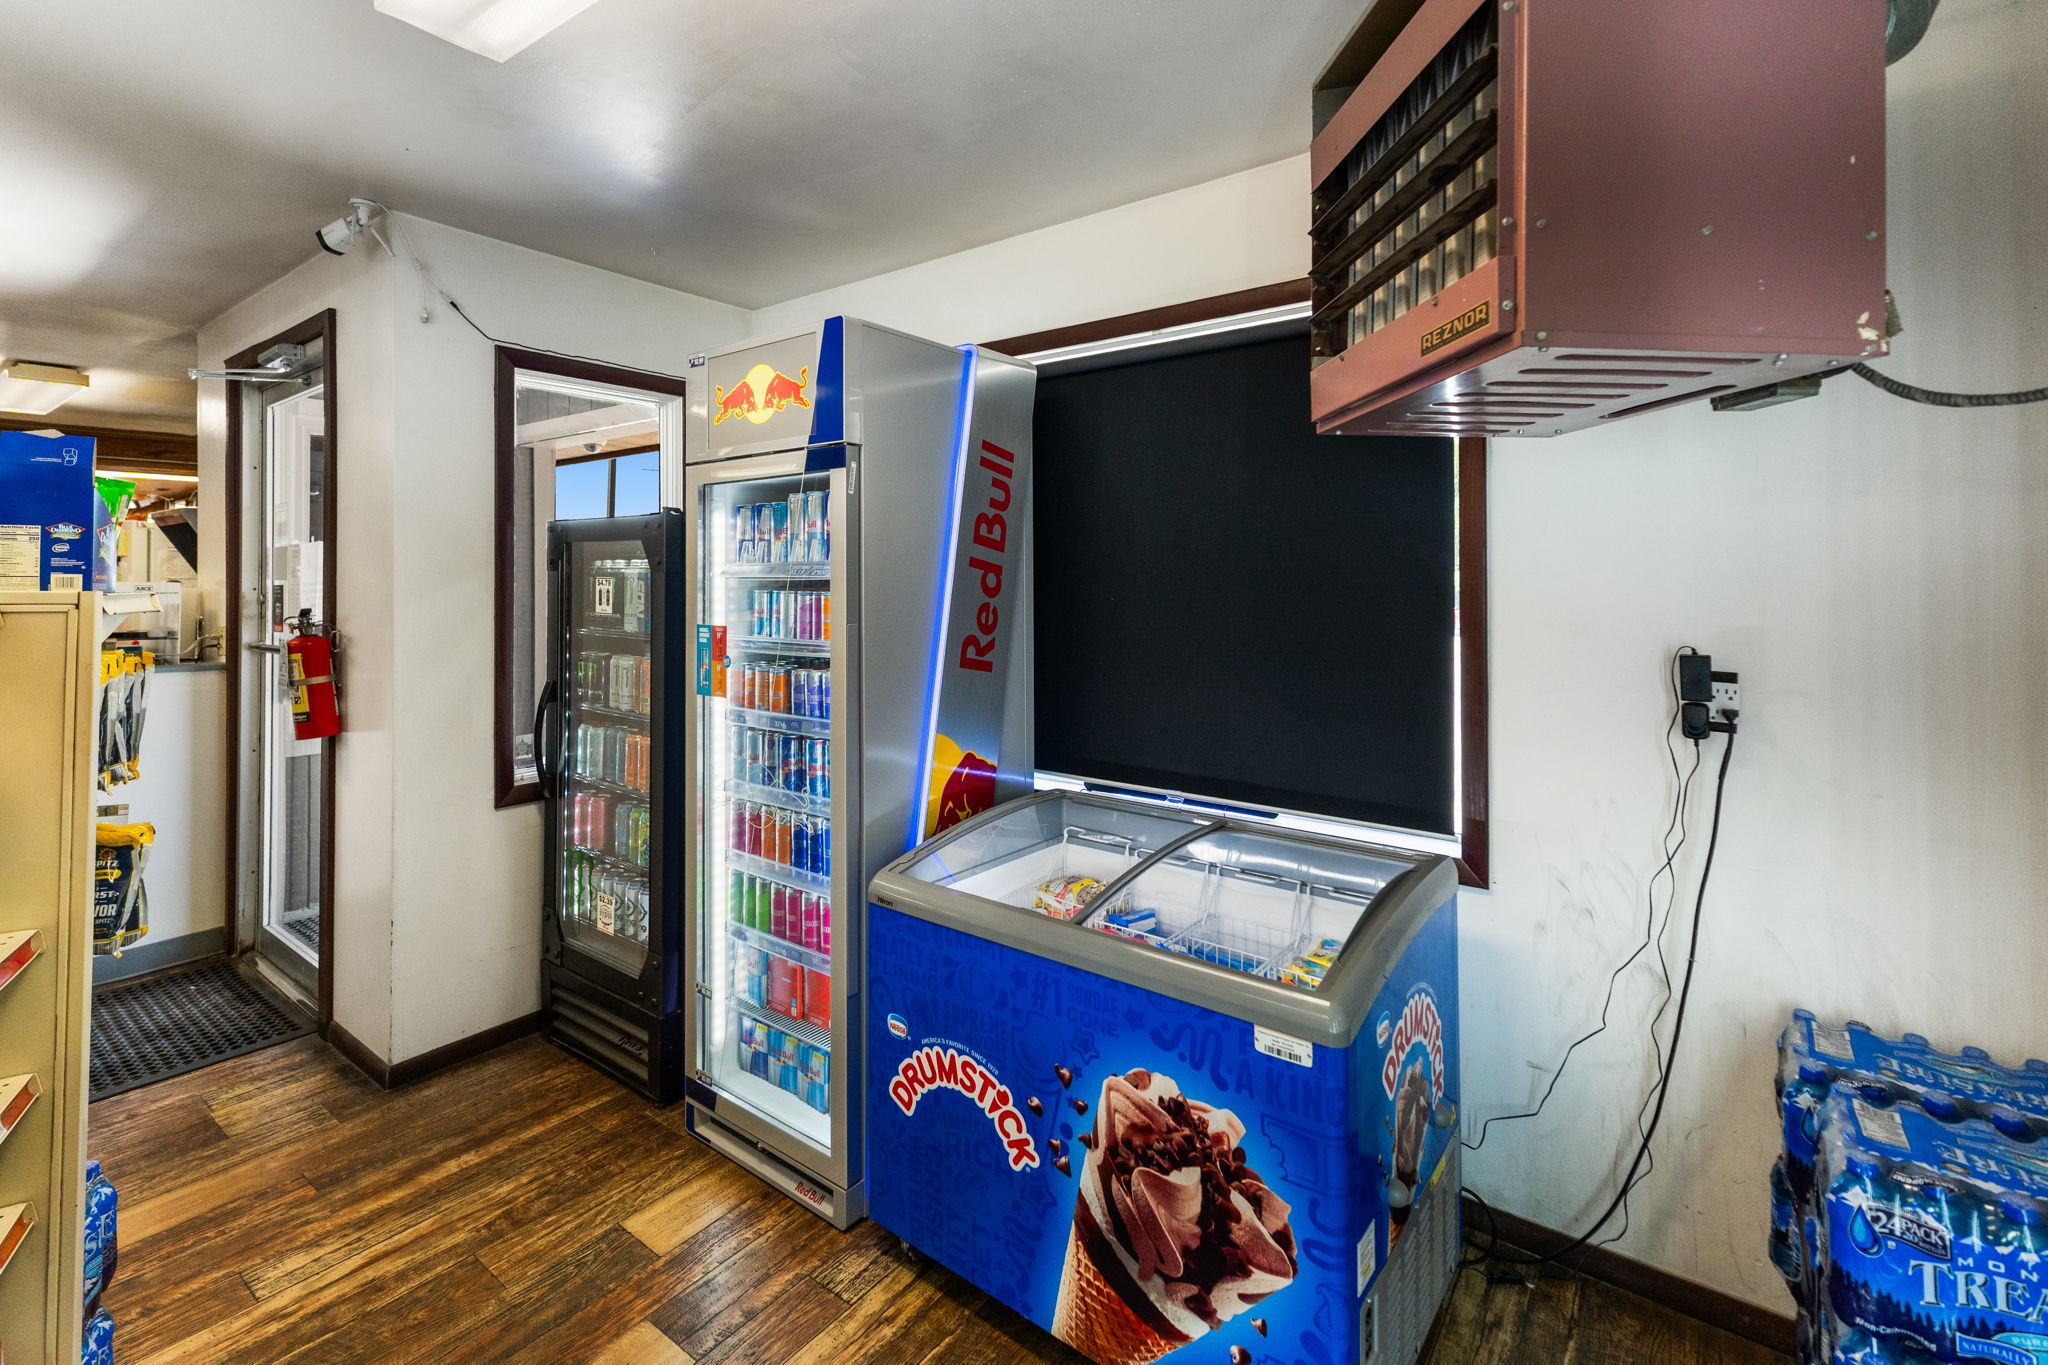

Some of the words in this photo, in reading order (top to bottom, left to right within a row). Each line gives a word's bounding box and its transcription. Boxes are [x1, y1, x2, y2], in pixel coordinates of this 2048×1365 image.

[1422, 304, 1487, 350] REZNOR
[972, 439, 1015, 553] Bull
[597, 579, 612, 587] $4.79
[959, 556, 1003, 673] Red
[95, 859, 119, 867] PITZ
[971, 1049, 987, 1065] SINCE
[890, 1048, 1038, 1168] DRUMSTICK
[794, 1182, 812, 1197] Red
[808, 1190, 826, 1206] Bull
[1871, 1211, 1901, 1236] 24
[1901, 1218, 1944, 1246] PACK
